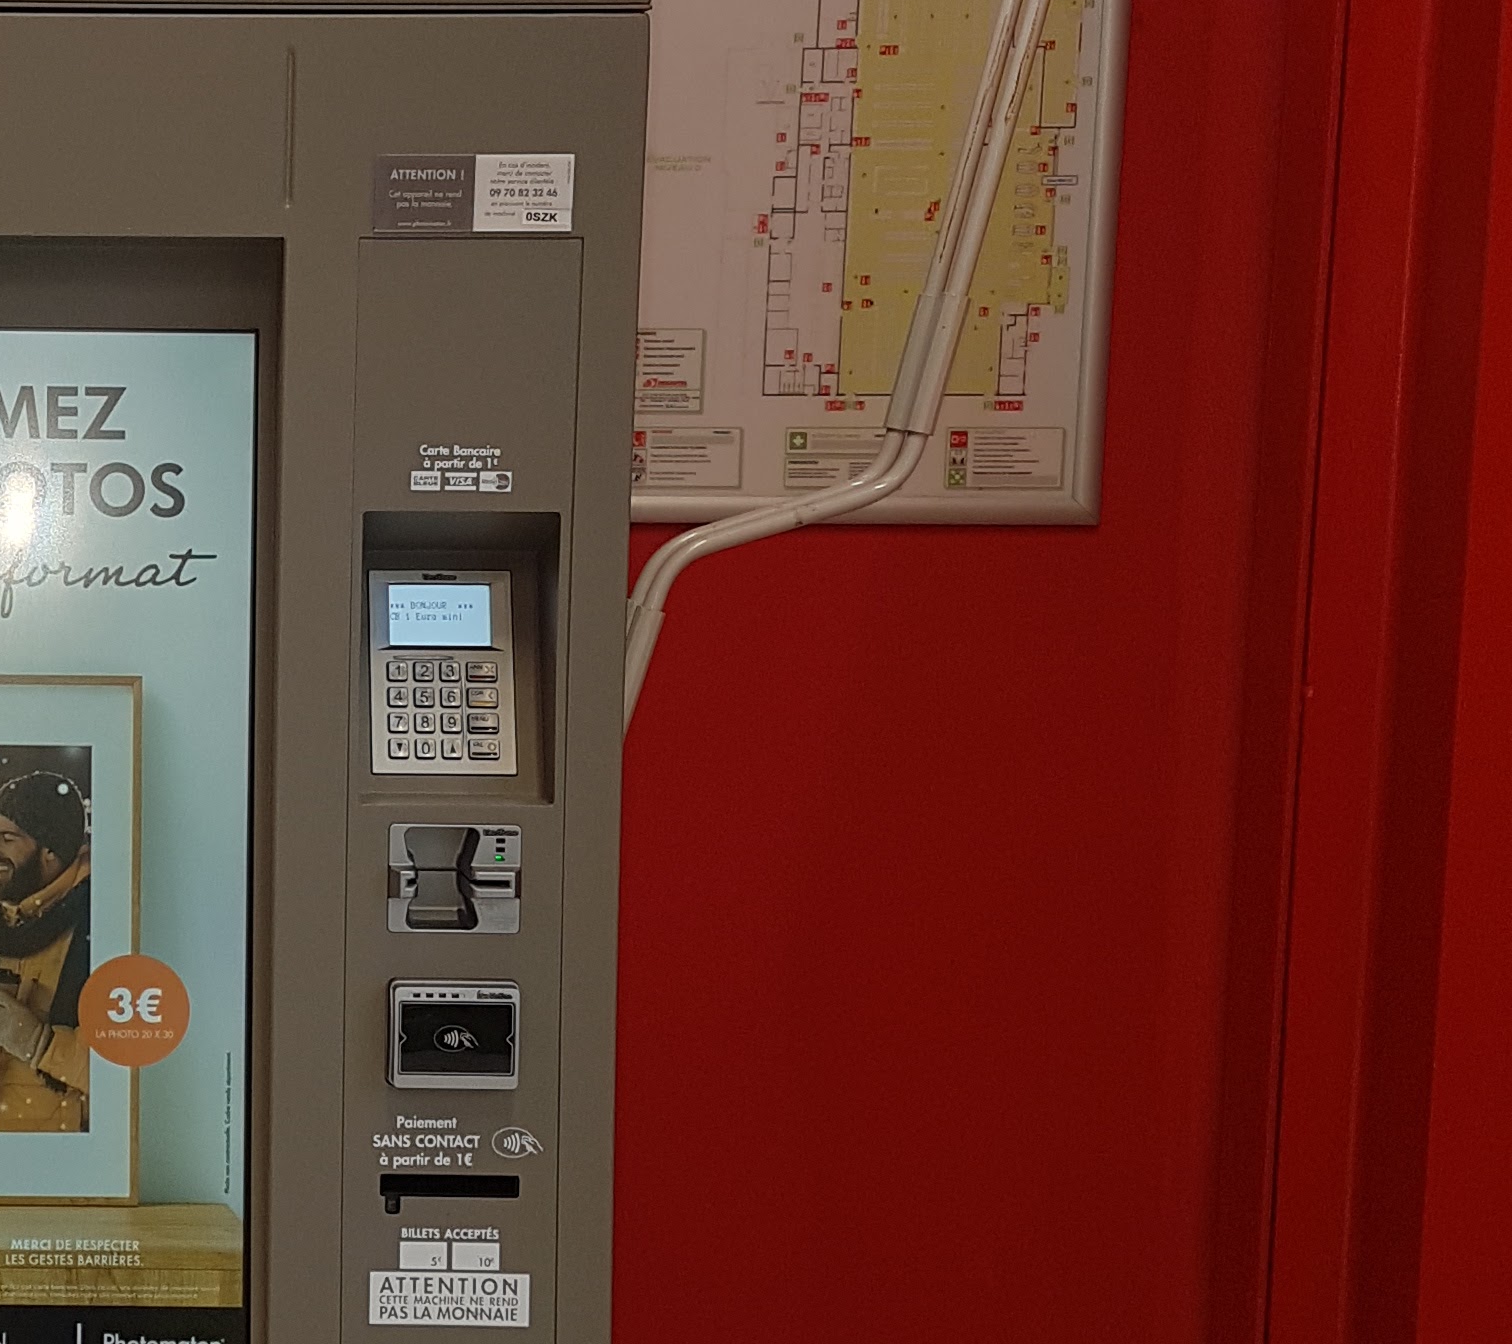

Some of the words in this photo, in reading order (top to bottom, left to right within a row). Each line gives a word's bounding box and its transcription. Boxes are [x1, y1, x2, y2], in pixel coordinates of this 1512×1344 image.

[390, 168, 456, 180] ATTENTION
[490, 189, 501, 197] 09
[504, 189, 515, 197] 70
[532, 189, 543, 197] 32
[419, 444, 449, 455] Carte
[453, 444, 501, 456] Bancaire
[423, 457, 431, 468] à
[435, 457, 466, 472] partir
[469, 457, 482, 468] de
[410, 601, 447, 610] BONJOUR
[395, 665, 401, 676] 1
[421, 665, 429, 676] 2
[446, 665, 454, 677] 3
[394, 690, 403, 701] 4
[420, 690, 428, 703] 5
[448, 691, 456, 703] 6
[395, 716, 403, 728] 7
[421, 716, 429, 728] 8
[448, 717, 456, 728] 9
[422, 742, 430, 754] 0
[107, 987, 162, 1023] 3€
[95, 1030, 106, 1038] LA
[108, 1030, 139, 1038] PHOTO
[142, 1030, 153, 1038] 20
[164, 1031, 174, 1039] 30
[396, 1115, 457, 1128] Paiement
[373, 1135, 410, 1147] SANS
[415, 1135, 480, 1148] CONTACT
[380, 1152, 388, 1165] à
[393, 1152, 430, 1169] partir
[434, 1151, 451, 1165] de
[401, 1228, 440, 1239] BILLETS
[444, 1227, 499, 1240] ACCEPTÉS
[11, 1239, 51, 1250] MERCI
[56, 1239, 71, 1250] DE
[76, 1240, 139, 1251] RESPECTER
[5, 1254, 25, 1265] LES
[29, 1254, 73, 1266] GESTES
[380, 1277, 517, 1295] ATTENTION
[379, 1295, 408, 1304] CETTE
[414, 1296, 464, 1305] MACHINE
[470, 1297, 484, 1306] NE
[490, 1297, 518, 1306] REND
[379, 1306, 407, 1319] PAS
[414, 1307, 433, 1319] LA
[437, 1307, 517, 1321] MONNAIE
